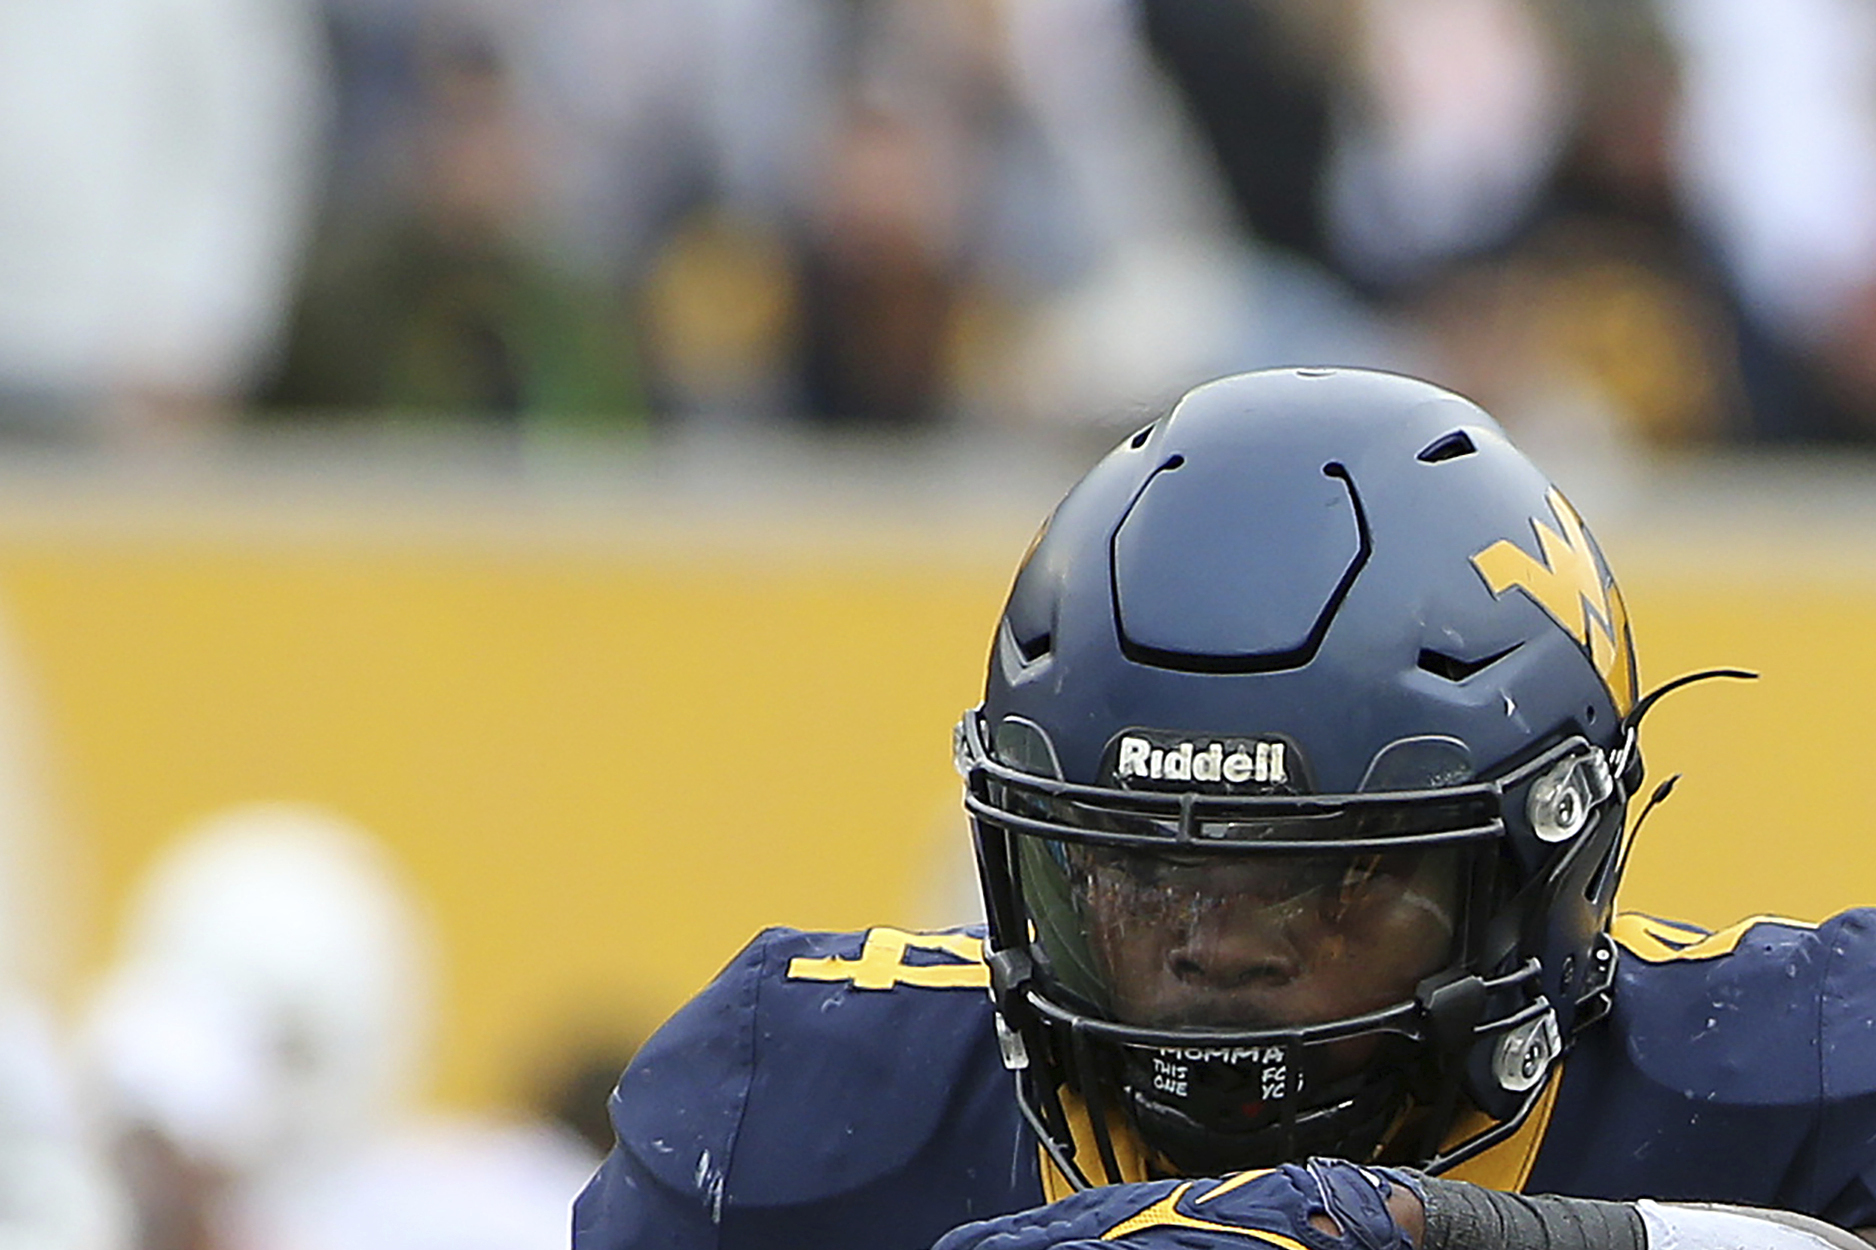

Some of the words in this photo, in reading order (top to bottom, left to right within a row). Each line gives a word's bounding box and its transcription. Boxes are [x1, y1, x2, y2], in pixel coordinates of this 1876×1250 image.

[1119, 737, 1287, 783] Riddell
[1153, 1058, 1188, 1079] THIS
[1153, 1075, 1187, 1097] ONE
